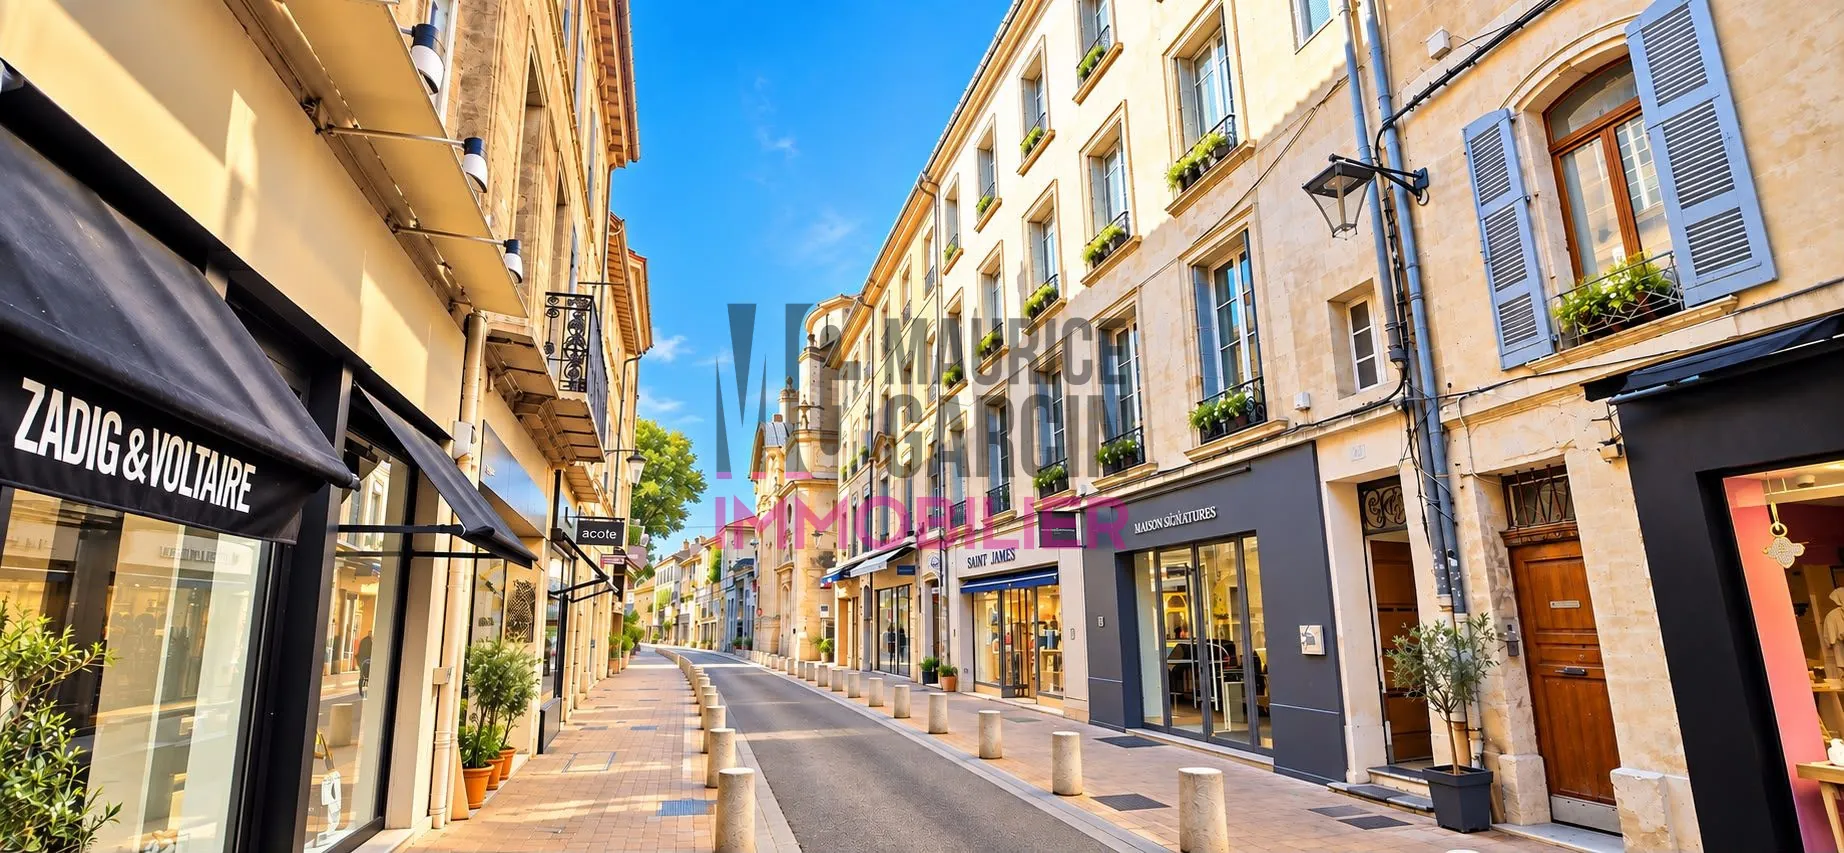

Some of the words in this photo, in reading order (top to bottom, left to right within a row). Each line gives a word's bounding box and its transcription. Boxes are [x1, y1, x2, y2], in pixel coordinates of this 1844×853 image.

[1134, 517, 1163, 534] MAISON
[1163, 505, 1218, 529] SIGNATURES
[582, 530, 617, 539] acote
[967, 553, 987, 569] SAINT
[991, 547, 1016, 565] JAMES
